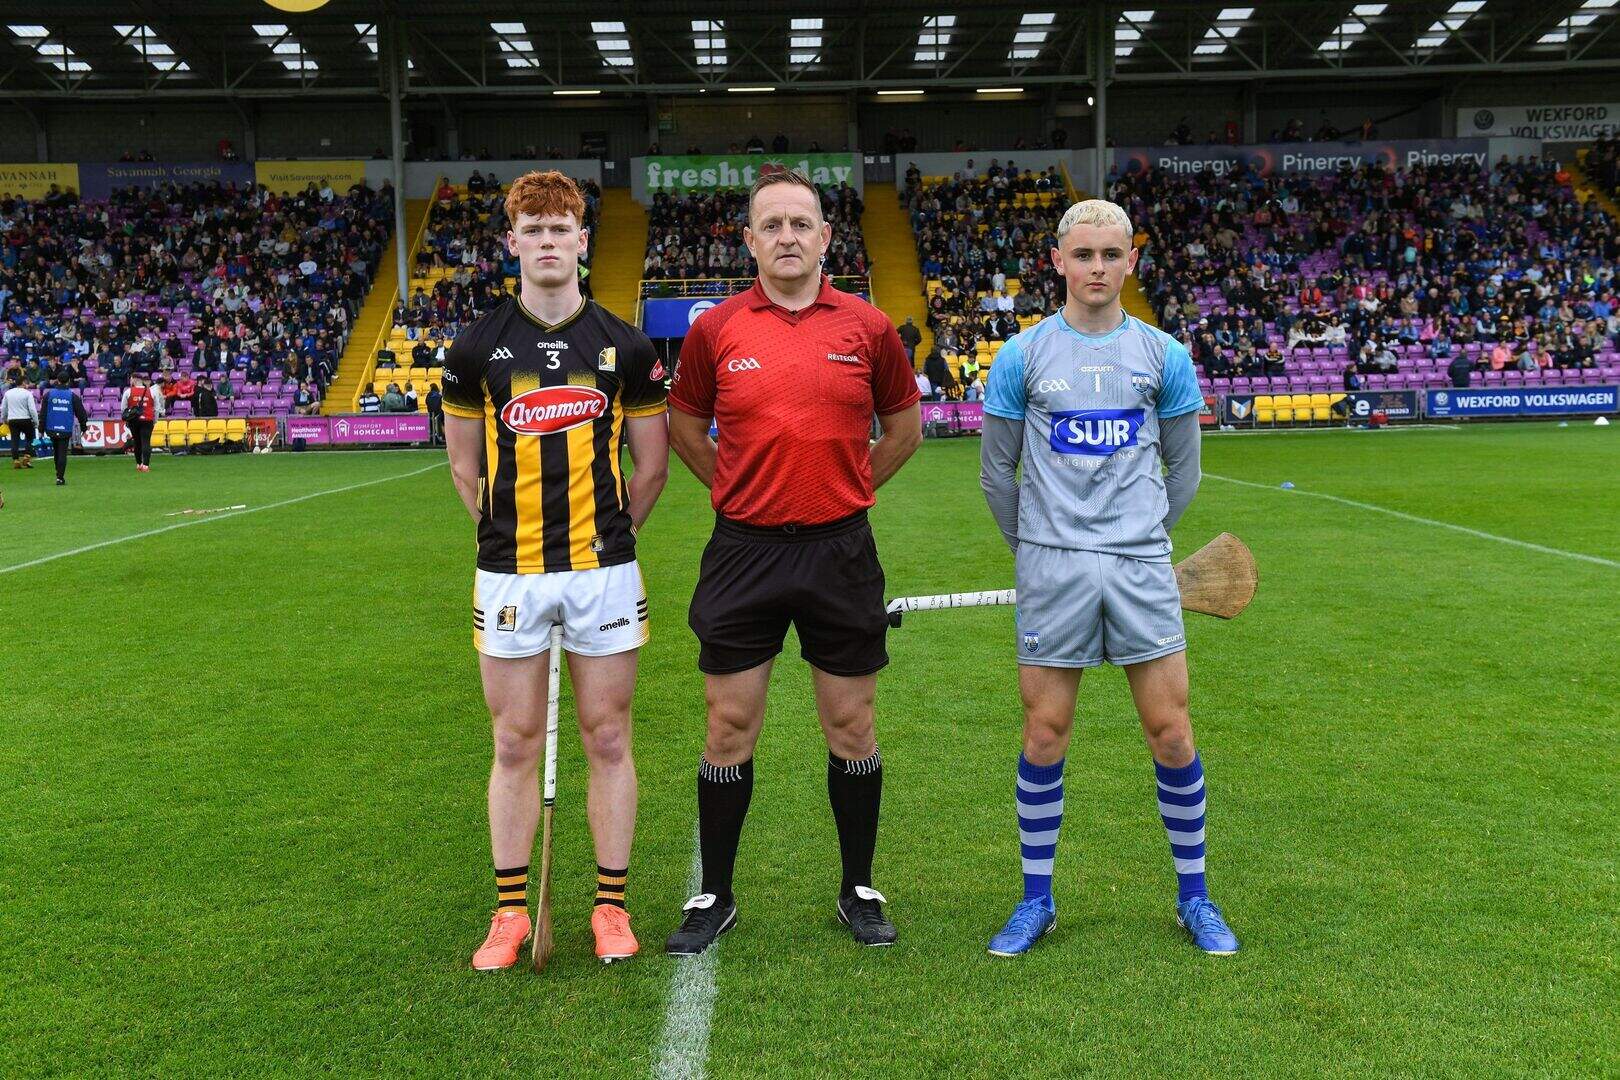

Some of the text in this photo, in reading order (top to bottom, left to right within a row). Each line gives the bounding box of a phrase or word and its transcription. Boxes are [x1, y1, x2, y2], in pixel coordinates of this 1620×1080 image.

[1526, 106, 1608, 122] WEXFORD
[1159, 156, 1238, 176] Pinergy
[1283, 152, 1362, 173] Pinergy
[1407, 149, 1487, 168] Pinergy
[0, 171, 57, 181] VANNAH
[172, 166, 222, 178] Georgia
[546, 351, 561, 369] 3
[727, 357, 762, 372] GAA
[1038, 378, 1071, 393] GAA
[1095, 373, 1101, 392] 1
[1456, 393, 1613, 408] WEXFORD VOLKSWAGEN
[1067, 419, 1130, 446] SUIR
[1056, 450, 1137, 468] ENGINEING
